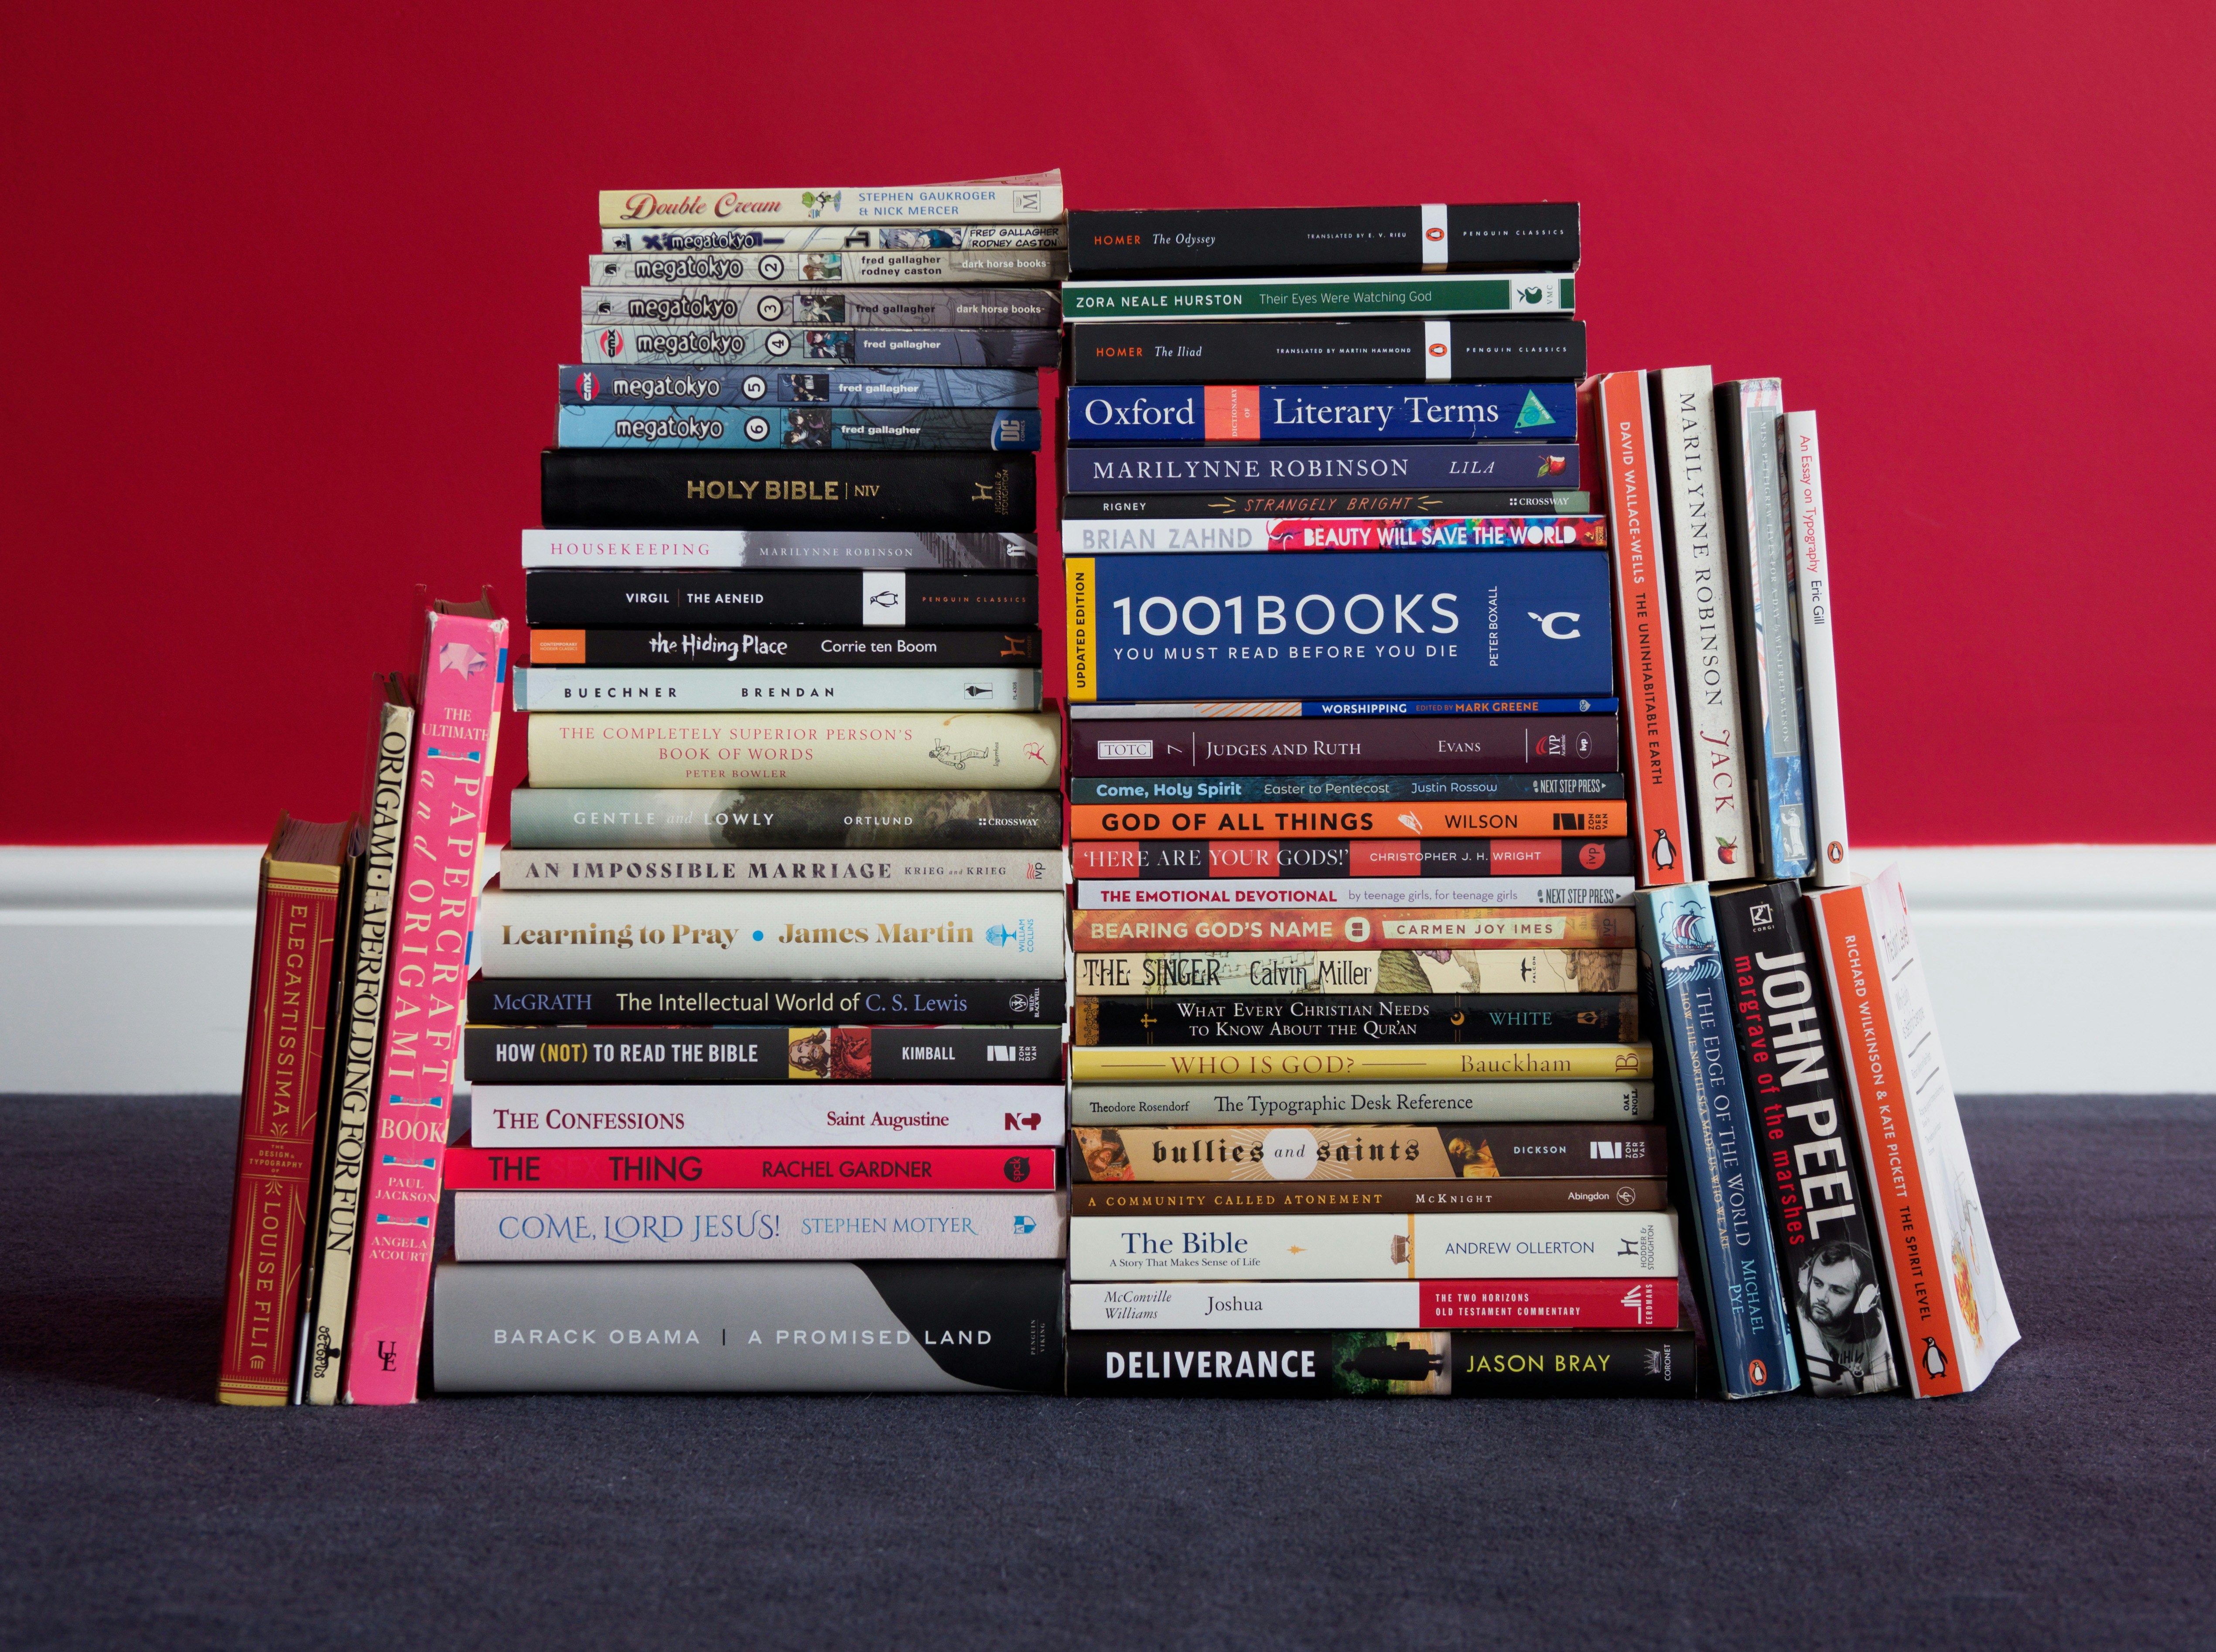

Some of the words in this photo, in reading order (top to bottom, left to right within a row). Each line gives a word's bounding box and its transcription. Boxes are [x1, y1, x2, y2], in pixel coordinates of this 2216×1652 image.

[859, 192, 913, 201] STEPHEN
[920, 191, 995, 201] GAUKROGER
[620, 193, 707, 218] Double
[714, 192, 782, 218] Cream
[1000, 228, 1059, 236] GALLAGHER
[1094, 236, 1140, 245] HOMER
[1153, 234, 1171, 244] The
[1176, 233, 1215, 247] Odyssey
[889, 256, 941, 266] gallagher
[635, 256, 743, 282] megatokyo
[861, 267, 900, 276] rodney
[1076, 297, 1115, 308] ZORA
[1121, 296, 1168, 307] NEALE
[1174, 295, 1242, 306] HURSTON
[613, 374, 721, 400] megatokyo
[866, 384, 918, 393] gallagher
[1085, 398, 1195, 425] Oxford
[1245, 408, 1250, 417] OF
[1274, 398, 1394, 431] Literary
[1404, 397, 1499, 423] Terms
[1800, 435, 1810, 452] An
[1449, 462, 1495, 474] LILA
[1801, 456, 1812, 485] Essay
[687, 481, 759, 499] HOLY
[766, 480, 838, 500] BIBLE
[854, 485, 879, 496] NIV
[1805, 489, 1812, 503] on
[1083, 529, 1155, 549] BRIAN
[1169, 528, 1252, 549] ZAHND
[1803, 507, 1820, 573] Typography
[551, 544, 710, 555] HOUSEKEEPING
[760, 548, 839, 556] MARILYNNE
[846, 548, 912, 556] ROBINSON
[1811, 580, 1822, 602] Eric
[626, 594, 669, 603] VIRGIL
[687, 594, 710, 603] THE
[715, 594, 763, 603] AENEID
[1076, 573, 1084, 625] EDITION
[1113, 596, 1242, 636] 1001
[1258, 593, 1458, 635] BOOKS
[1489, 586, 1498, 629] BOXALL
[1813, 604, 1824, 625] Gill
[1490, 633, 1498, 666] PETER
[1076, 631, 1085, 687] UPDATED
[564, 688, 676, 698] BUECHNER
[742, 688, 833, 697] BRENDAN
[1322, 704, 1407, 714] WORSHIPPING
[1456, 703, 1489, 712] MARK
[1493, 702, 1538, 711] GREENE
[560, 728, 594, 739] THE
[603, 728, 722, 739] COMPLETELY
[730, 728, 817, 740] SUPERIOR
[1412, 782, 1446, 794] Justin
[1451, 783, 1497, 792] Rossow
[844, 816, 912, 826] ORTLUND
[1445, 814, 1517, 829] WILSON
[1370, 853, 1456, 862] CHRISTOPHER
[1462, 852, 1472, 861] J.
[1477, 852, 1487, 860] H.
[1493, 852, 1541, 861] WRIGHT
[779, 924, 868, 943] James
[875, 921, 974, 943] Martin
[1397, 925, 1466, 935] CARMEN
[1475, 925, 1505, 934] JOY
[1514, 924, 1553, 934] IMES
[1845, 935, 1867, 997] RICHARD
[1490, 1012, 1553, 1025] WHITE
[1755, 952, 1830, 1087] JOHN
[1858, 1001, 1885, 1085] WILKINSON
[902, 1047, 955, 1060] KIMBALL
[1461, 1053, 1571, 1073] Bauckham
[1876, 1091, 1887, 1100] &
[1090, 1102, 1135, 1113] Theodore
[1139, 1101, 1190, 1112] Rosendorf
[493, 1109, 539, 1130] THE
[546, 1109, 684, 1130] CONFESSIONS
[827, 1111, 865, 1126] Saint
[870, 1111, 949, 1131] Augustine
[1879, 1105, 1895, 1146] KATE
[249, 1159, 302, 1168] TYPOGRAPHY
[763, 1162, 833, 1177] RACHEL
[839, 1161, 931, 1177] GARDNER
[1786, 1098, 1856, 1240] PEEL
[1887, 1143, 1907, 1198] PICKETT
[389, 1177, 424, 1189] PAUL
[376, 1189, 436, 1203] JACKSON
[1568, 1192, 1609, 1201] Abingdon
[1899, 1206, 1913, 1232] THE
[256, 1202, 280, 1291] LOUISE
[1445, 1242, 1511, 1254] ANDREW
[1516, 1242, 1594, 1253] OLLERTON
[1120, 1259, 1143, 1268] Story
[1146, 1259, 1168, 1267] That
[1171, 1258, 1198, 1266] Makes
[1202, 1258, 1227, 1266] Sense
[1243, 1258, 1260, 1266] Life
[1905, 1236, 1922, 1277] SPIRIT
[1104, 1290, 1171, 1303] McConville
[1915, 1281, 1931, 1321] LEVEL
[1205, 1296, 1263, 1315] Joshua
[1459, 1307, 1512, 1316] TESTAMENT
[1518, 1307, 1580, 1315] COMMENTARY
[1105, 1307, 1158, 1319] Williams
[251, 1302, 271, 1348] FILI
[495, 1330, 596, 1344] BARACK
[610, 1330, 700, 1344] OBAMA
[748, 1331, 762, 1344] A
[777, 1331, 911, 1344] PROMISED
[925, 1331, 991, 1344] LAND
